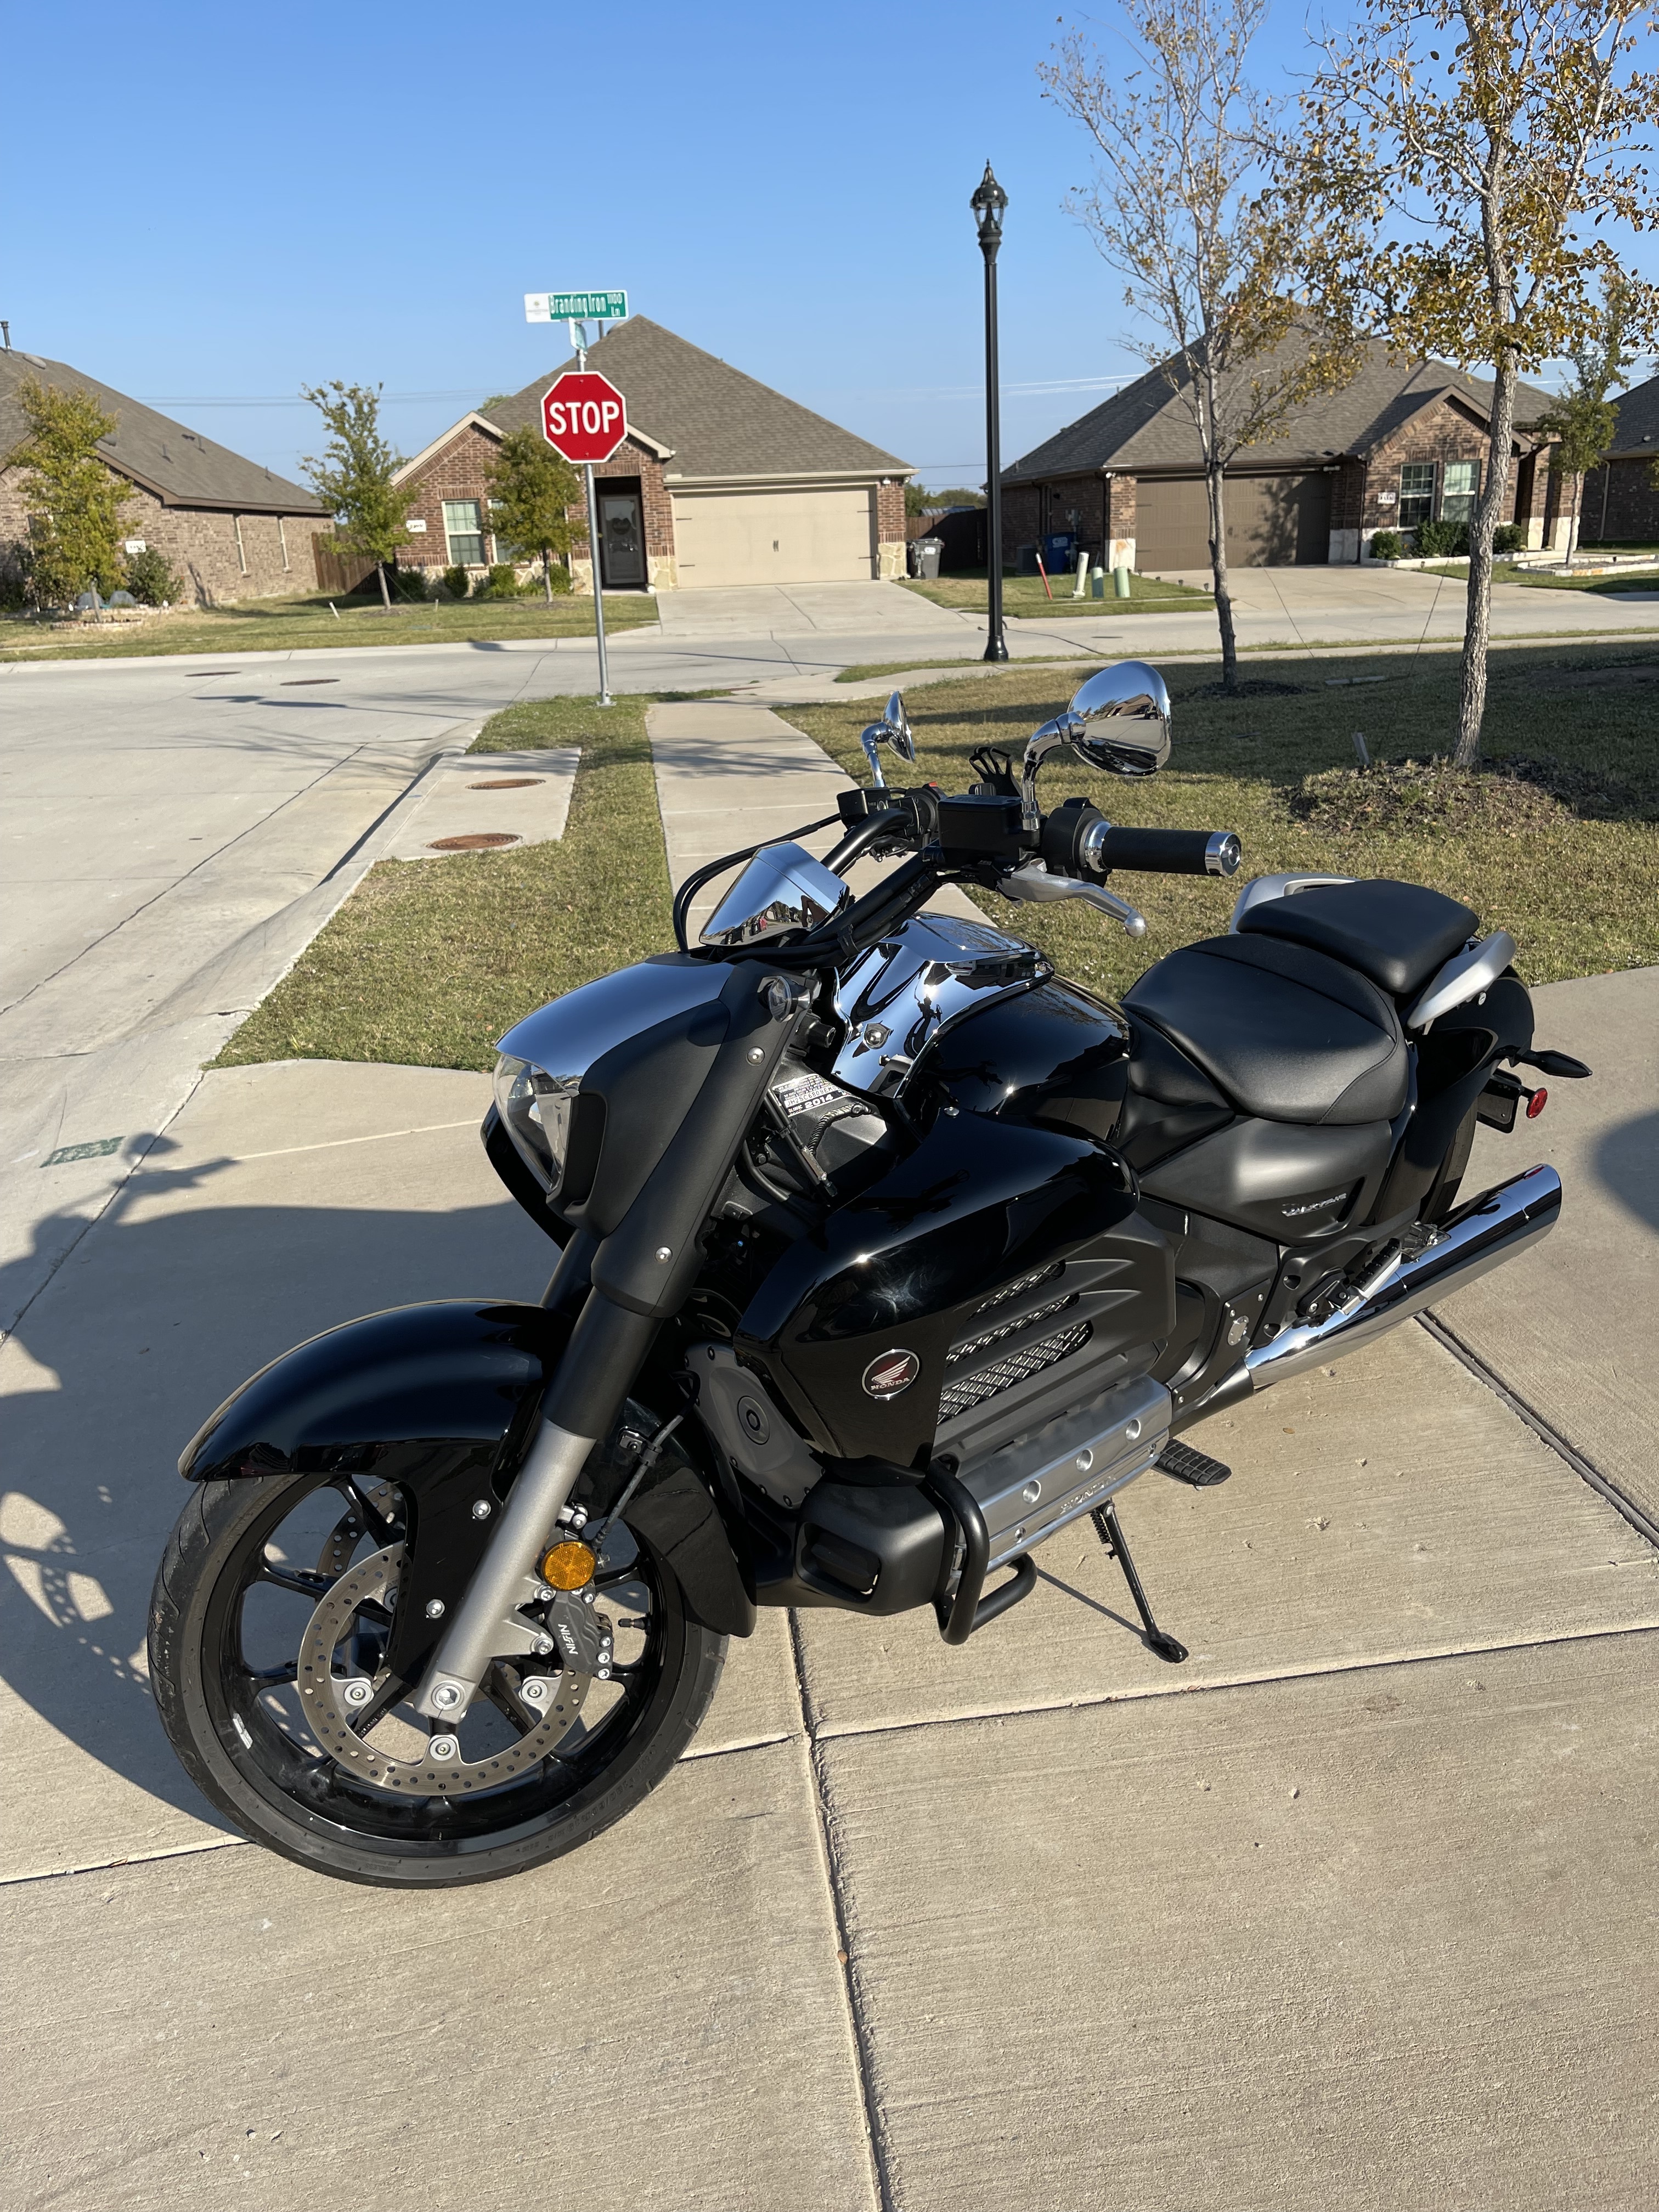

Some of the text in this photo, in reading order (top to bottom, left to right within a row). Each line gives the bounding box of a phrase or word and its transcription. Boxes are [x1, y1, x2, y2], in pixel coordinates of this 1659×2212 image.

[549, 294, 588, 318] Branding
[588, 294, 607, 312] Iron
[610, 306, 620, 317] Ln
[549, 400, 620, 435] STOP
[804, 1093, 833, 1109] 2014
[870, 1376, 910, 1391] HONDA
